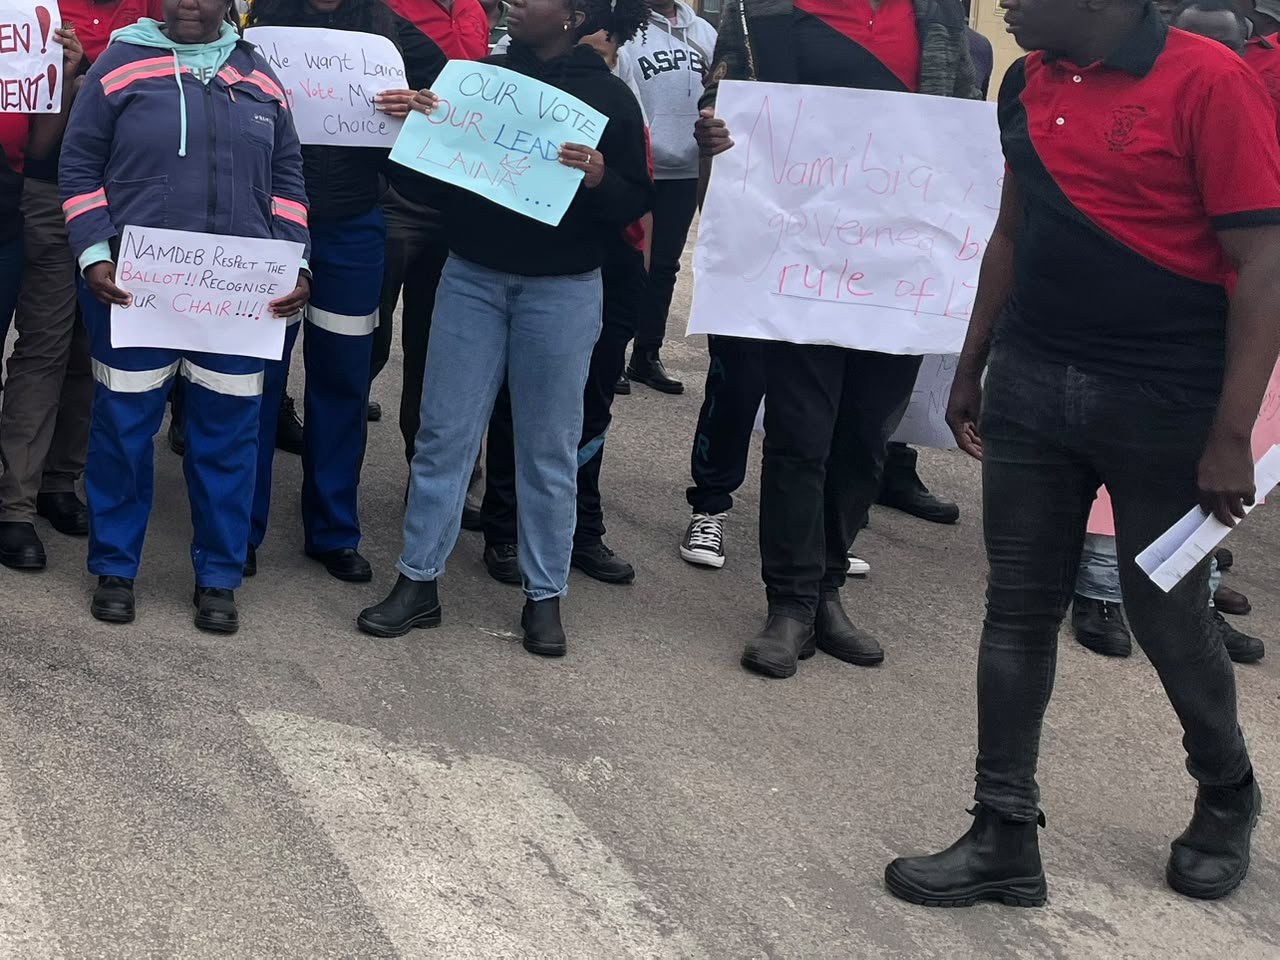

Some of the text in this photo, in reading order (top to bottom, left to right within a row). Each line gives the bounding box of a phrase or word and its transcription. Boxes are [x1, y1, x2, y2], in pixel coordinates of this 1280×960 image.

[258, 42, 291, 69] We
[304, 52, 354, 73] want
[322, 115, 392, 136] Choice
[426, 99, 487, 141] OUR
[459, 72, 597, 141] OUR VOTE
[742, 95, 933, 202] Namibia
[123, 231, 205, 266] NAMDEB
[264, 261, 288, 275] THE
[199, 269, 278, 295] RECOGNISE
[778, 258, 873, 299] rule
[895, 277, 935, 316] of
